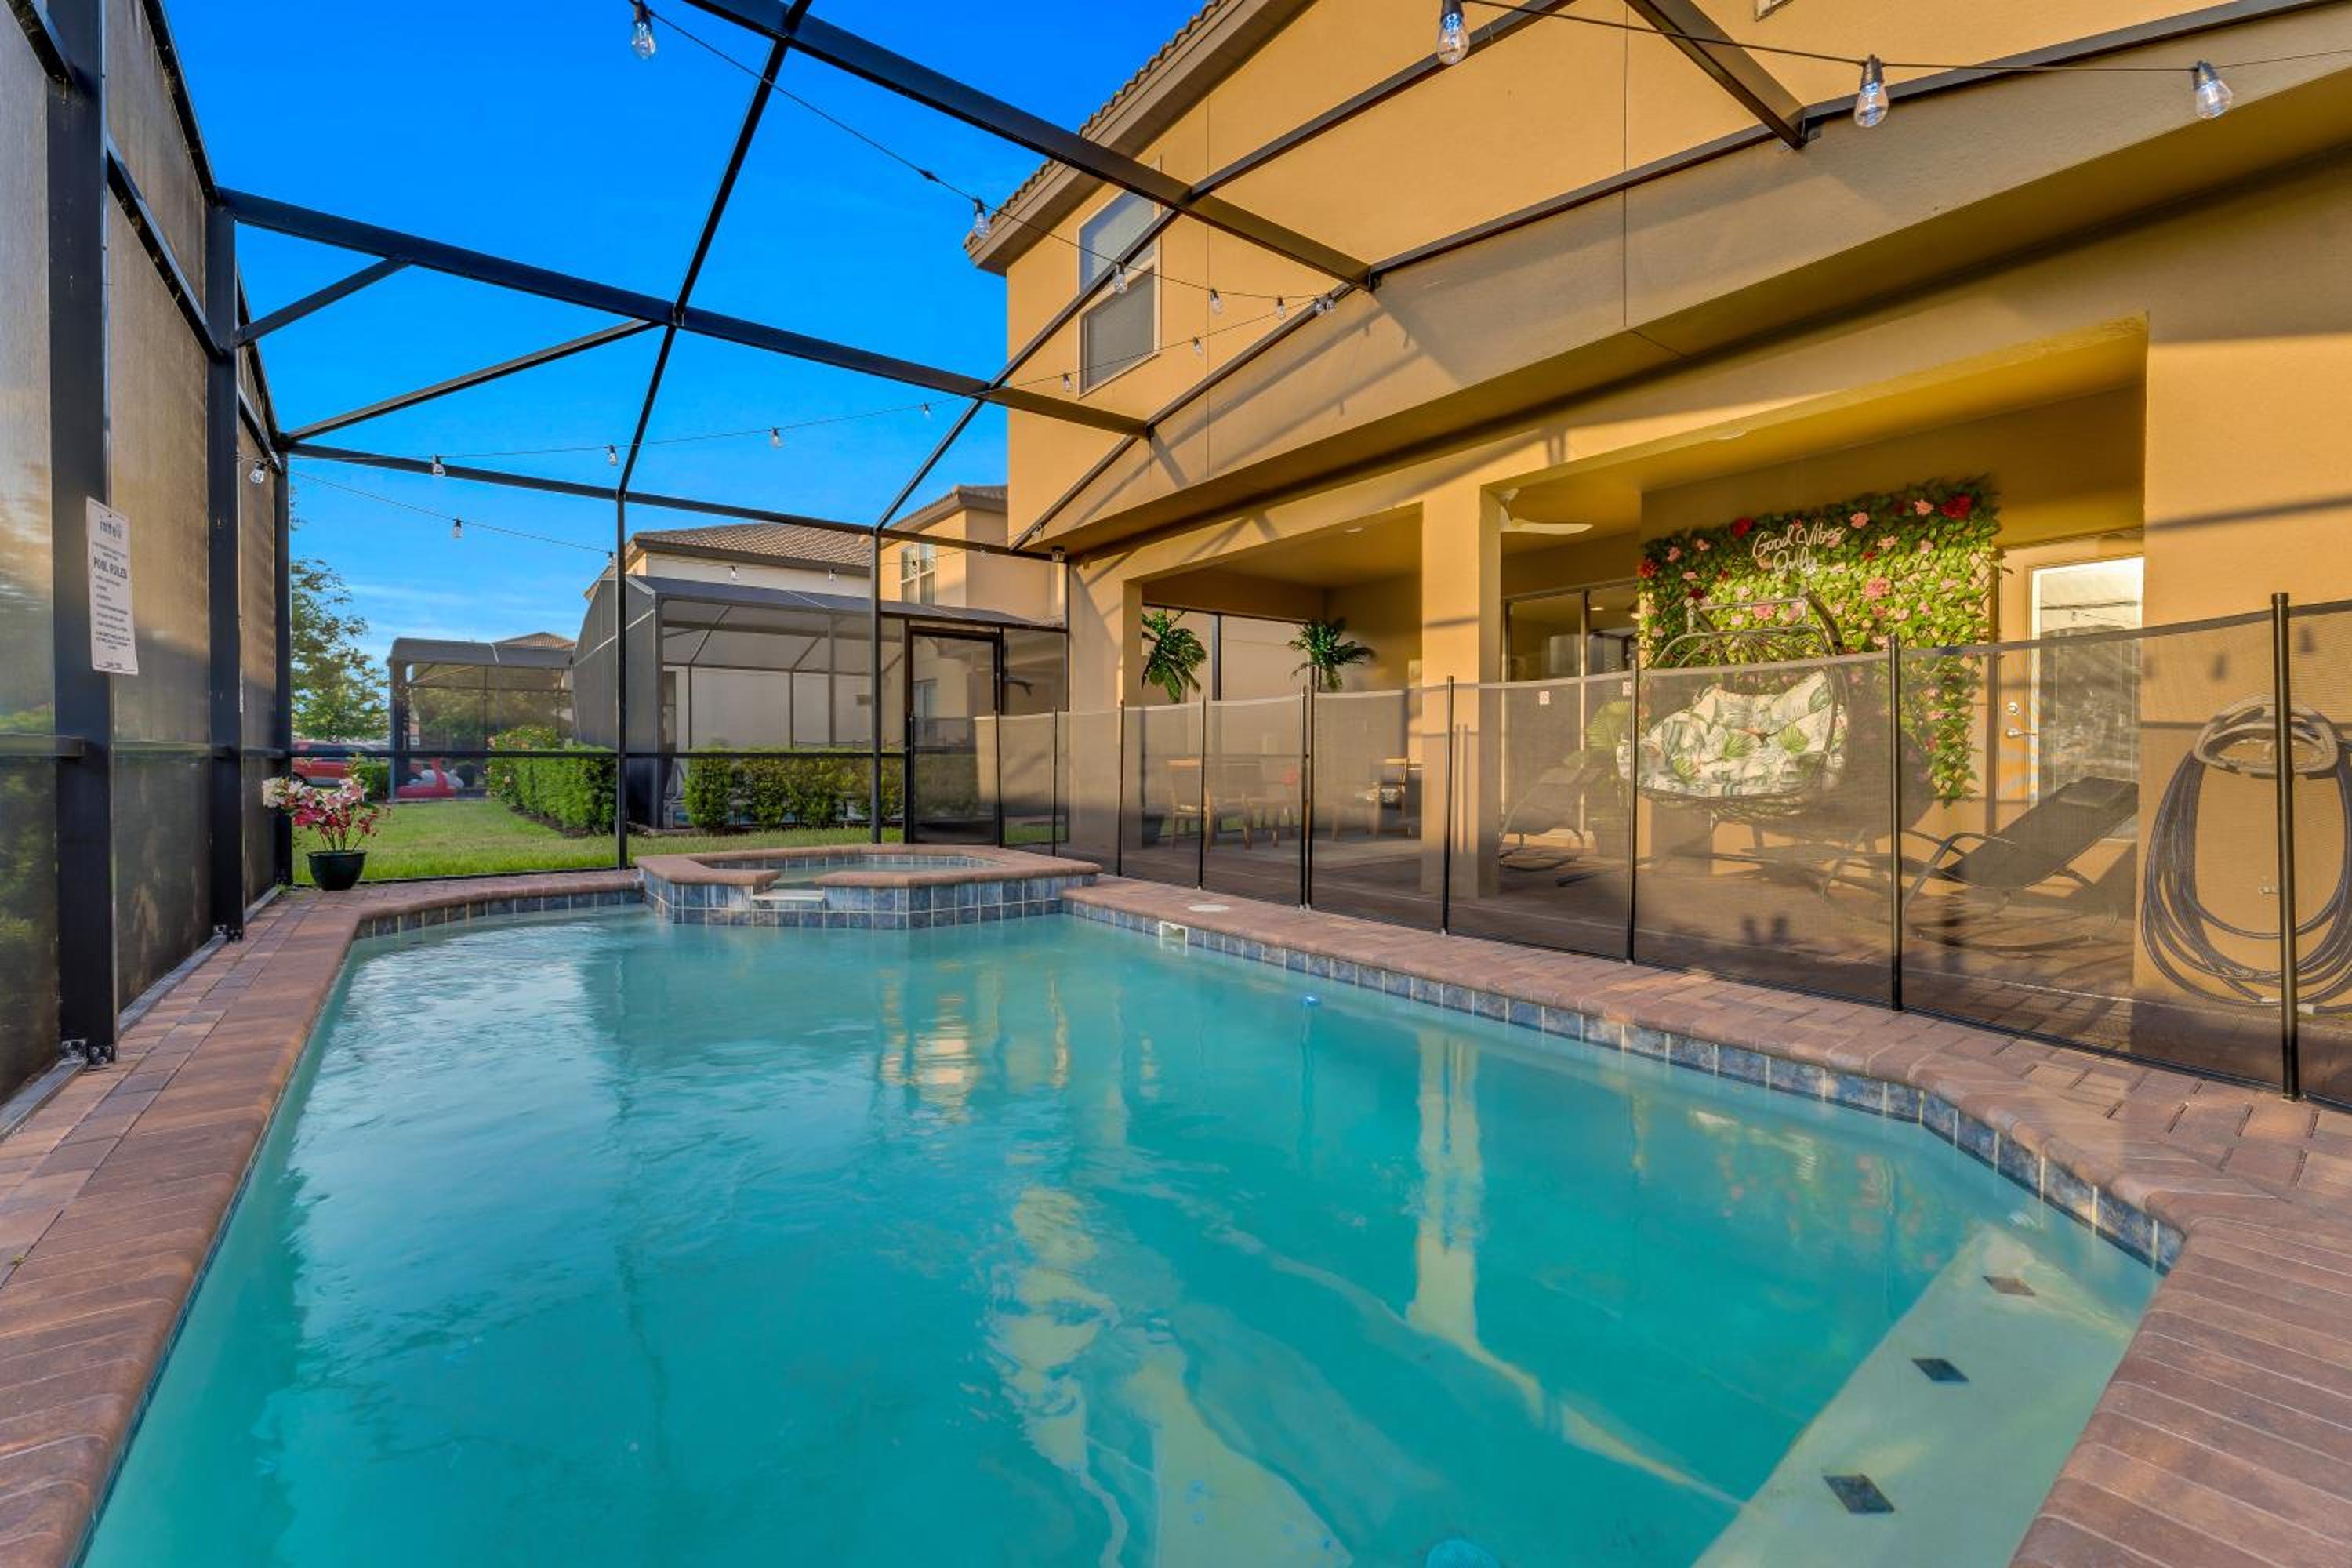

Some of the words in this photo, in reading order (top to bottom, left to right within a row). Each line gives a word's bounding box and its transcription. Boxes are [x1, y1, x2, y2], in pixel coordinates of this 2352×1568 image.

[1753, 524, 1795, 557] Good
[1796, 522, 1846, 546] Vibes
[93, 556, 108, 573] POOL
[110, 563, 128, 579] RULES
